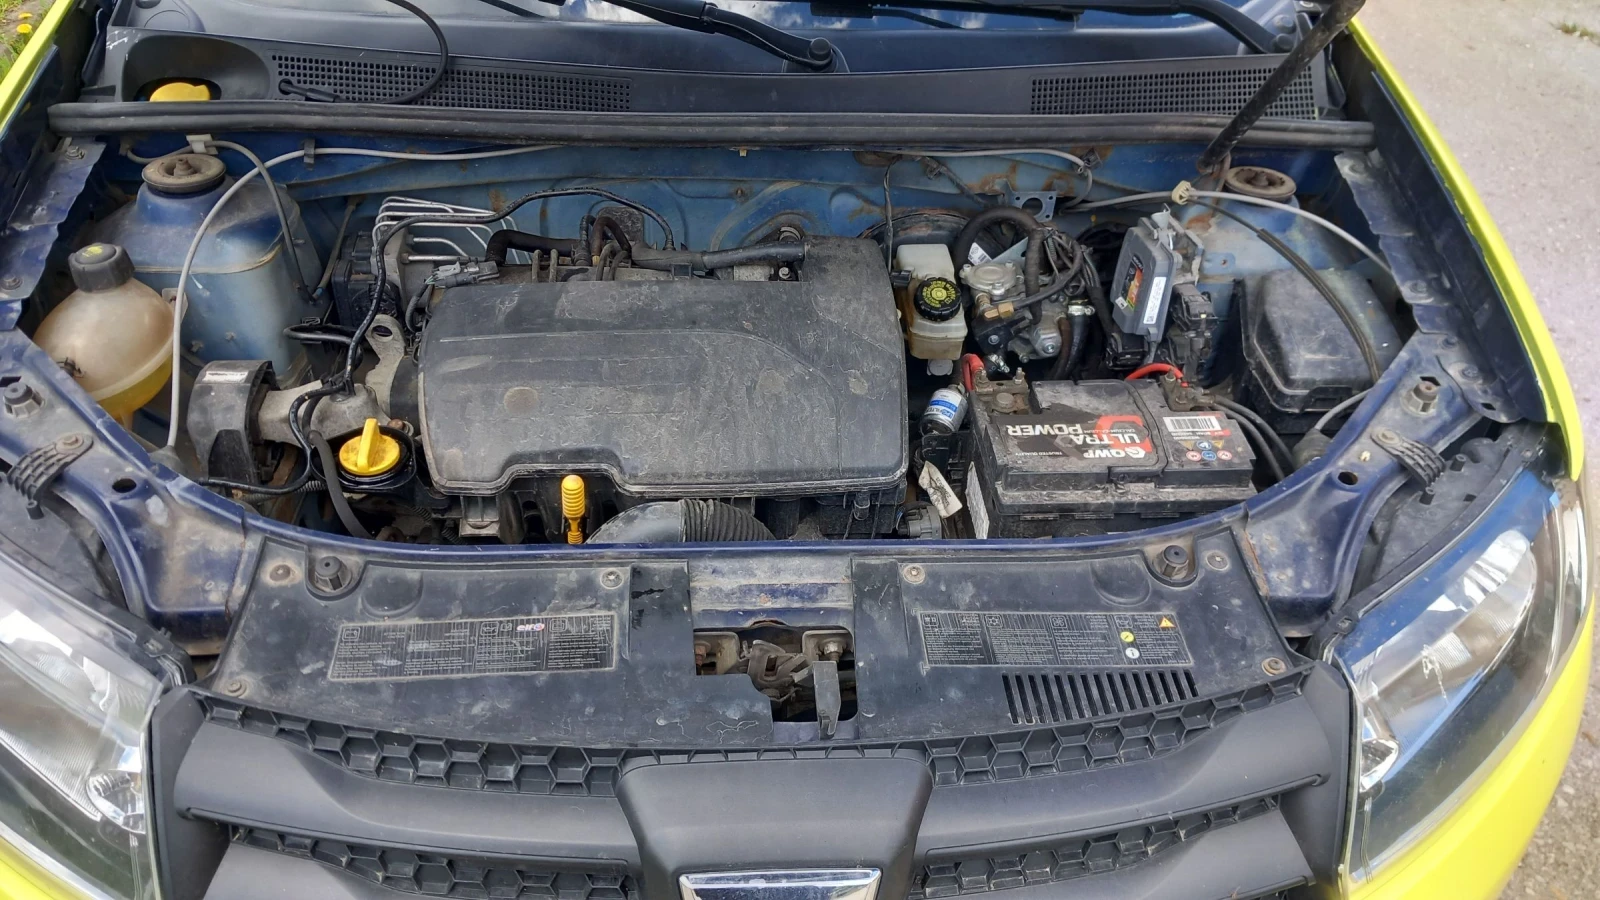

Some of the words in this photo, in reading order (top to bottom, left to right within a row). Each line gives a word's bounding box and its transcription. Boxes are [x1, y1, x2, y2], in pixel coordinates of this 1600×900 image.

[1006, 423, 1082, 436] POWER
[1070, 433, 1141, 445] ULTRA
[1083, 449, 1126, 459] QWP
